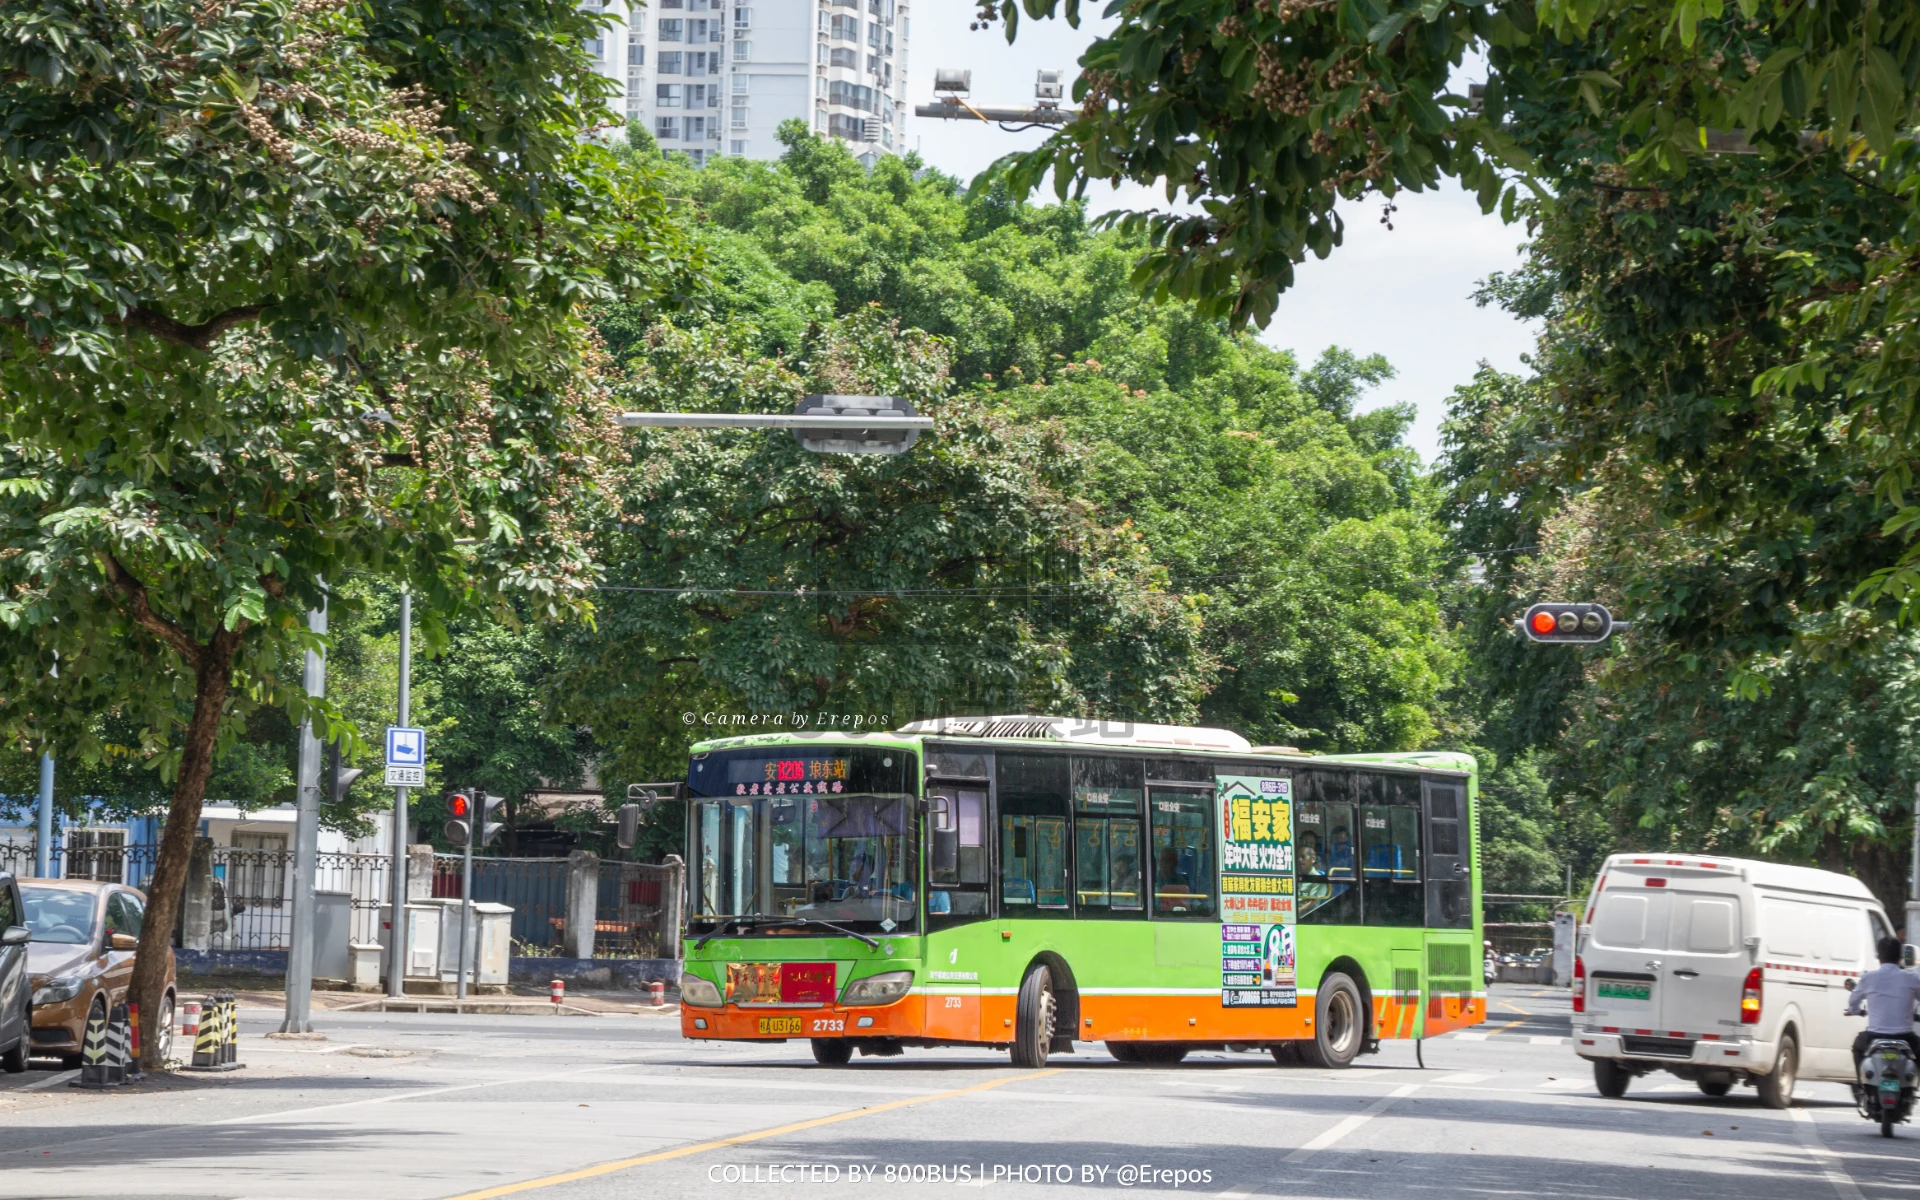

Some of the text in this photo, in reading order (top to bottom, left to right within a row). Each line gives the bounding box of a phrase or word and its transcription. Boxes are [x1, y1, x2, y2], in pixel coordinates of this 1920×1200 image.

[1232, 797, 1291, 842] 福安家
[1225, 843, 1292, 870] 年中大促 火力全开
[945, 996, 962, 1008] 2733
[813, 1019, 844, 1032] 2733
